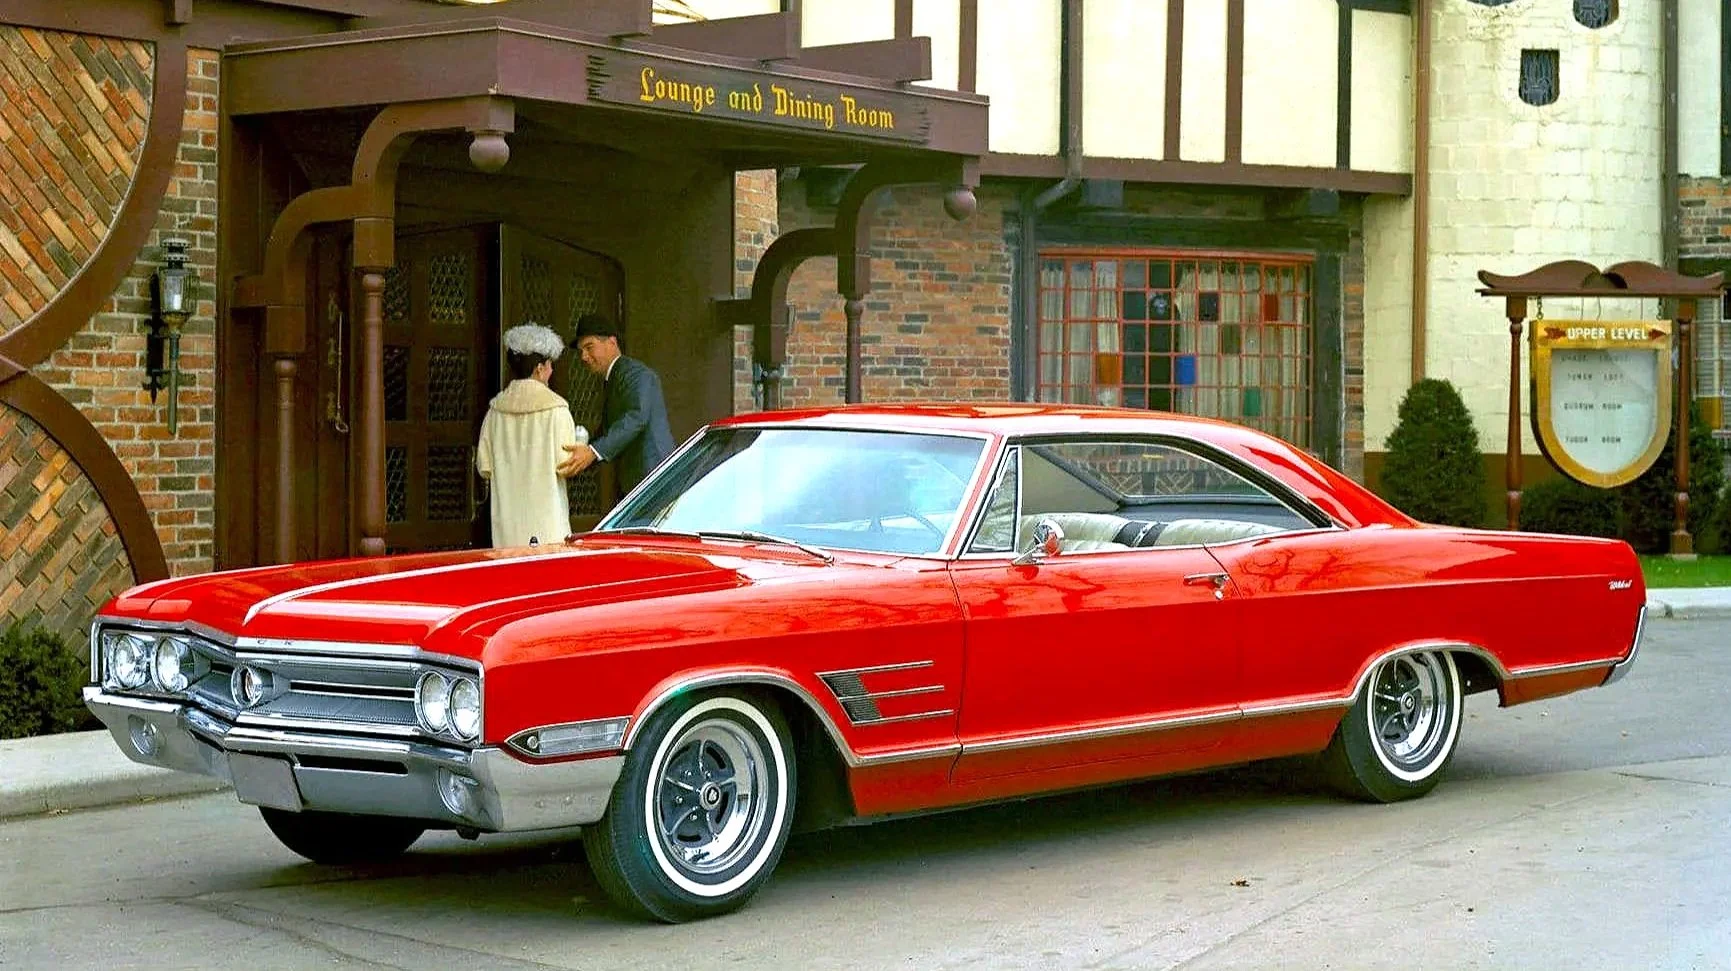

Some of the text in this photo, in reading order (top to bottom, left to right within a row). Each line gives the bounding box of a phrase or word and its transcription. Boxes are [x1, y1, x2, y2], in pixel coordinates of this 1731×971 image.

[640, 66, 894, 129] Lounge and Dining Room
[1567, 327, 1649, 340] UPPER LEVEL
